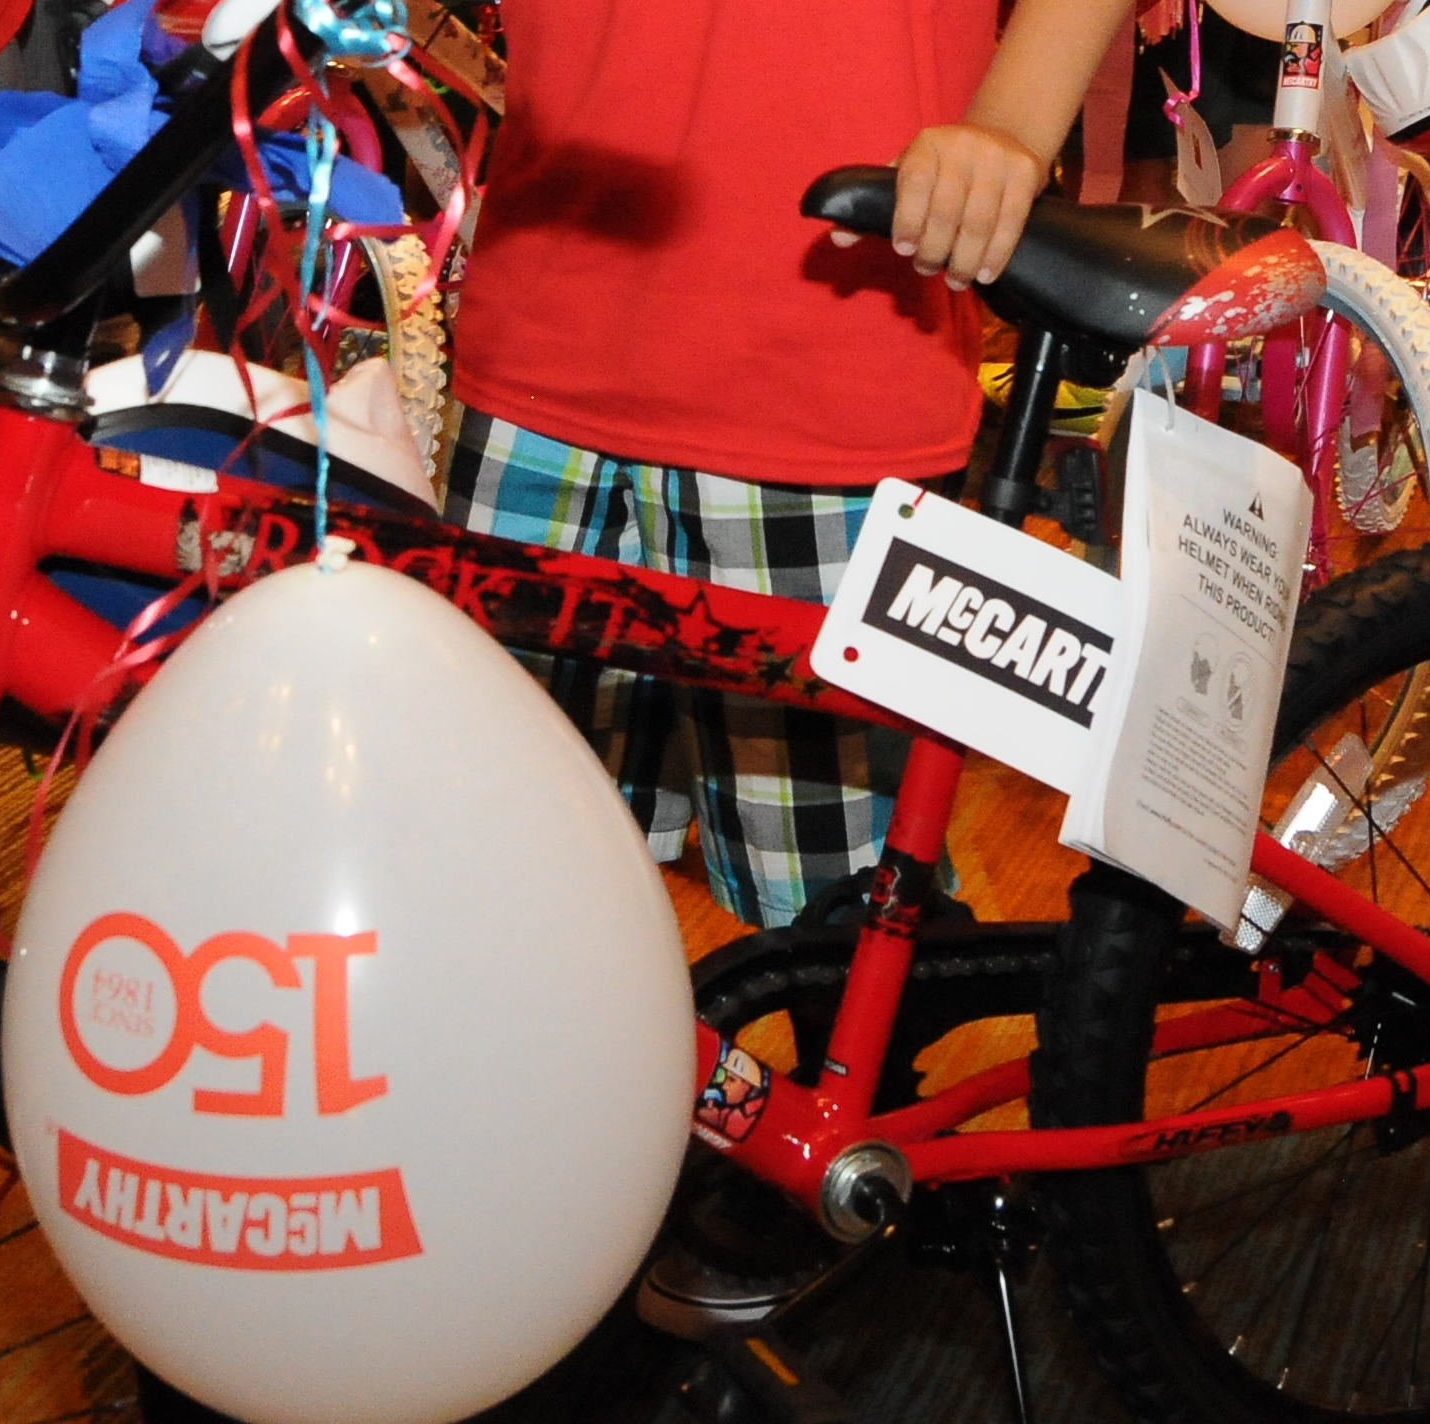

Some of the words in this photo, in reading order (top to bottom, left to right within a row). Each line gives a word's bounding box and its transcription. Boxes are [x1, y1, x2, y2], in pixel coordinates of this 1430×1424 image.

[1178, 534, 1231, 580] HELMET
[1232, 569, 1265, 606] WHEN
[1182, 513, 1238, 558] ALWAYS
[1240, 545, 1272, 584] WEAR
[1198, 573, 1224, 605] THIS
[59, 910, 389, 1118] 150
[73, 1158, 381, 1258] McCARTHY
